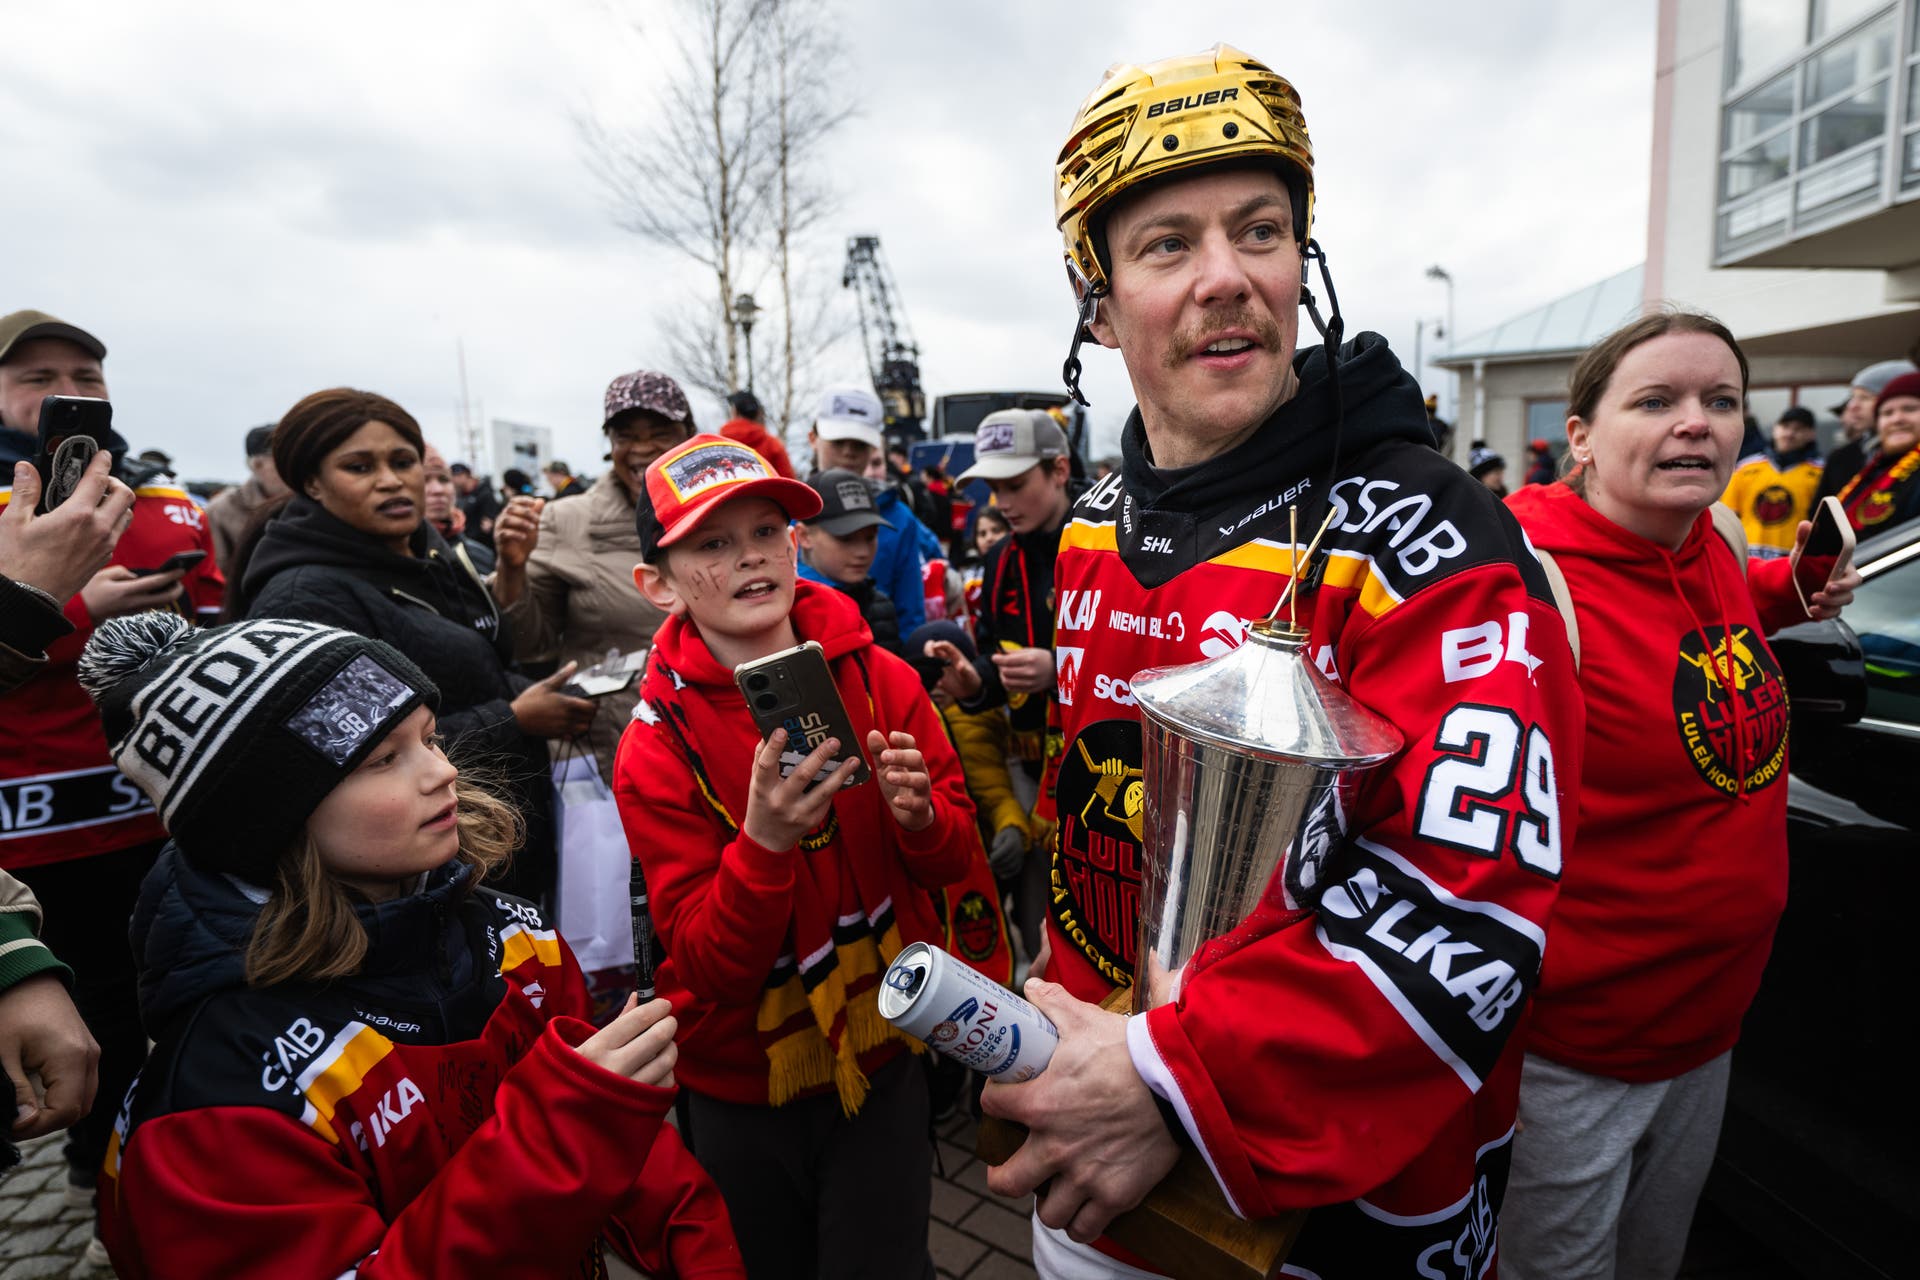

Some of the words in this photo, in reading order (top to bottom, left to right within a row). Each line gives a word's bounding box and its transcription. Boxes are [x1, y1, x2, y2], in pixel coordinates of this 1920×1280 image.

[1146, 87, 1239, 119] BAUER
[1141, 536, 1174, 554] SHL
[1327, 476, 1468, 577] SSAB
[1057, 589, 1102, 631] KAB
[1108, 609, 1146, 636] NIEMI
[135, 619, 318, 780] BEDA
[1681, 712, 1714, 769] LULEÅ
[1413, 702, 1563, 884] 29
[1365, 900, 1523, 1032] LKAB
